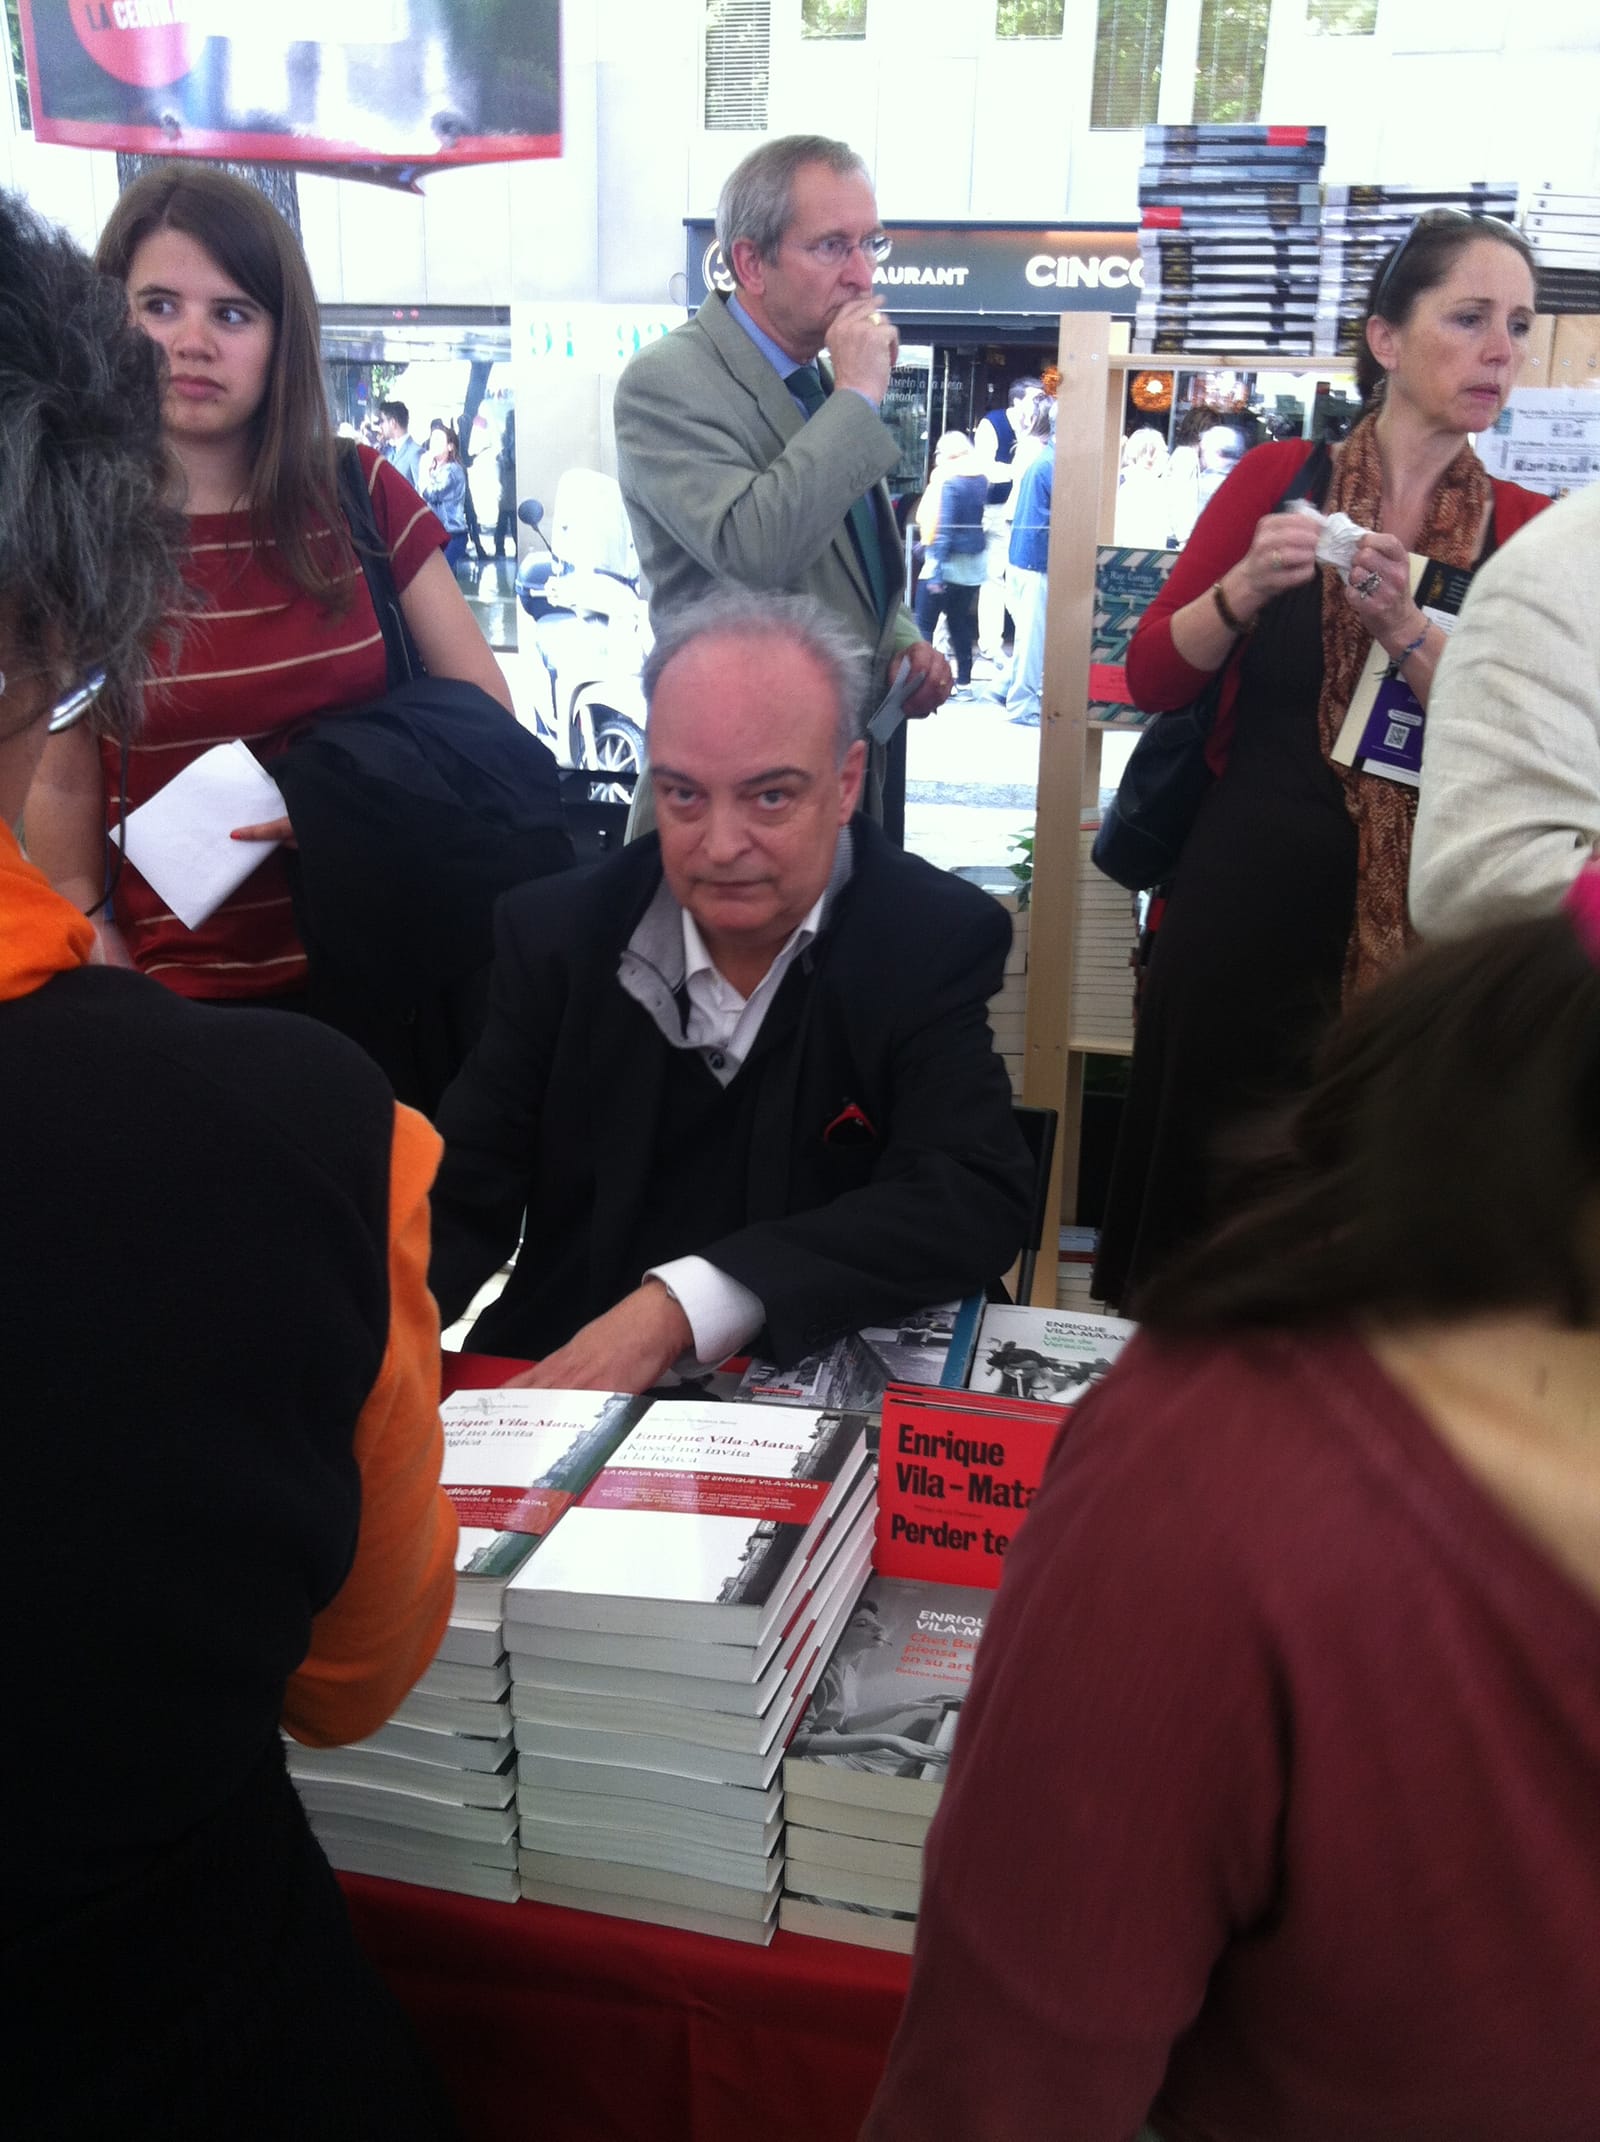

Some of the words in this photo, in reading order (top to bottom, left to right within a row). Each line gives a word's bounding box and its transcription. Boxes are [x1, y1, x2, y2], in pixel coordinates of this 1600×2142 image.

[84, 3, 111, 31] LA
[872, 266, 969, 285] AURANT
[1044, 1327, 1127, 1341] VILA-MATAS
[1046, 1321, 1107, 1332] ENRIQUE
[499, 1418, 585, 1430] Vila-Matas
[635, 1432, 705, 1444] Enrique
[709, 1435, 804, 1451] Vila-Matas
[898, 1423, 1005, 1467] Enrique
[706, 1444, 751, 1458] invita
[618, 1469, 653, 1477] NUEVA
[654, 1471, 694, 1480] NOVELA
[711, 1475, 757, 1485] ENRIQUE
[758, 1479, 819, 1490] VILA-MATAS
[968, 1473, 1040, 1509] Mata
[891, 1513, 977, 1551] Perder
[982, 1528, 1010, 1556] te
[919, 1610, 985, 1628] ENRIQU
[916, 1620, 981, 1637] VILA-M
[910, 1632, 948, 1647] Chet
[952, 1638, 979, 1651] Ba
[904, 1645, 957, 1659] piensa
[901, 1656, 921, 1664] en
[924, 1659, 944, 1668] su
[947, 1661, 974, 1672] art
